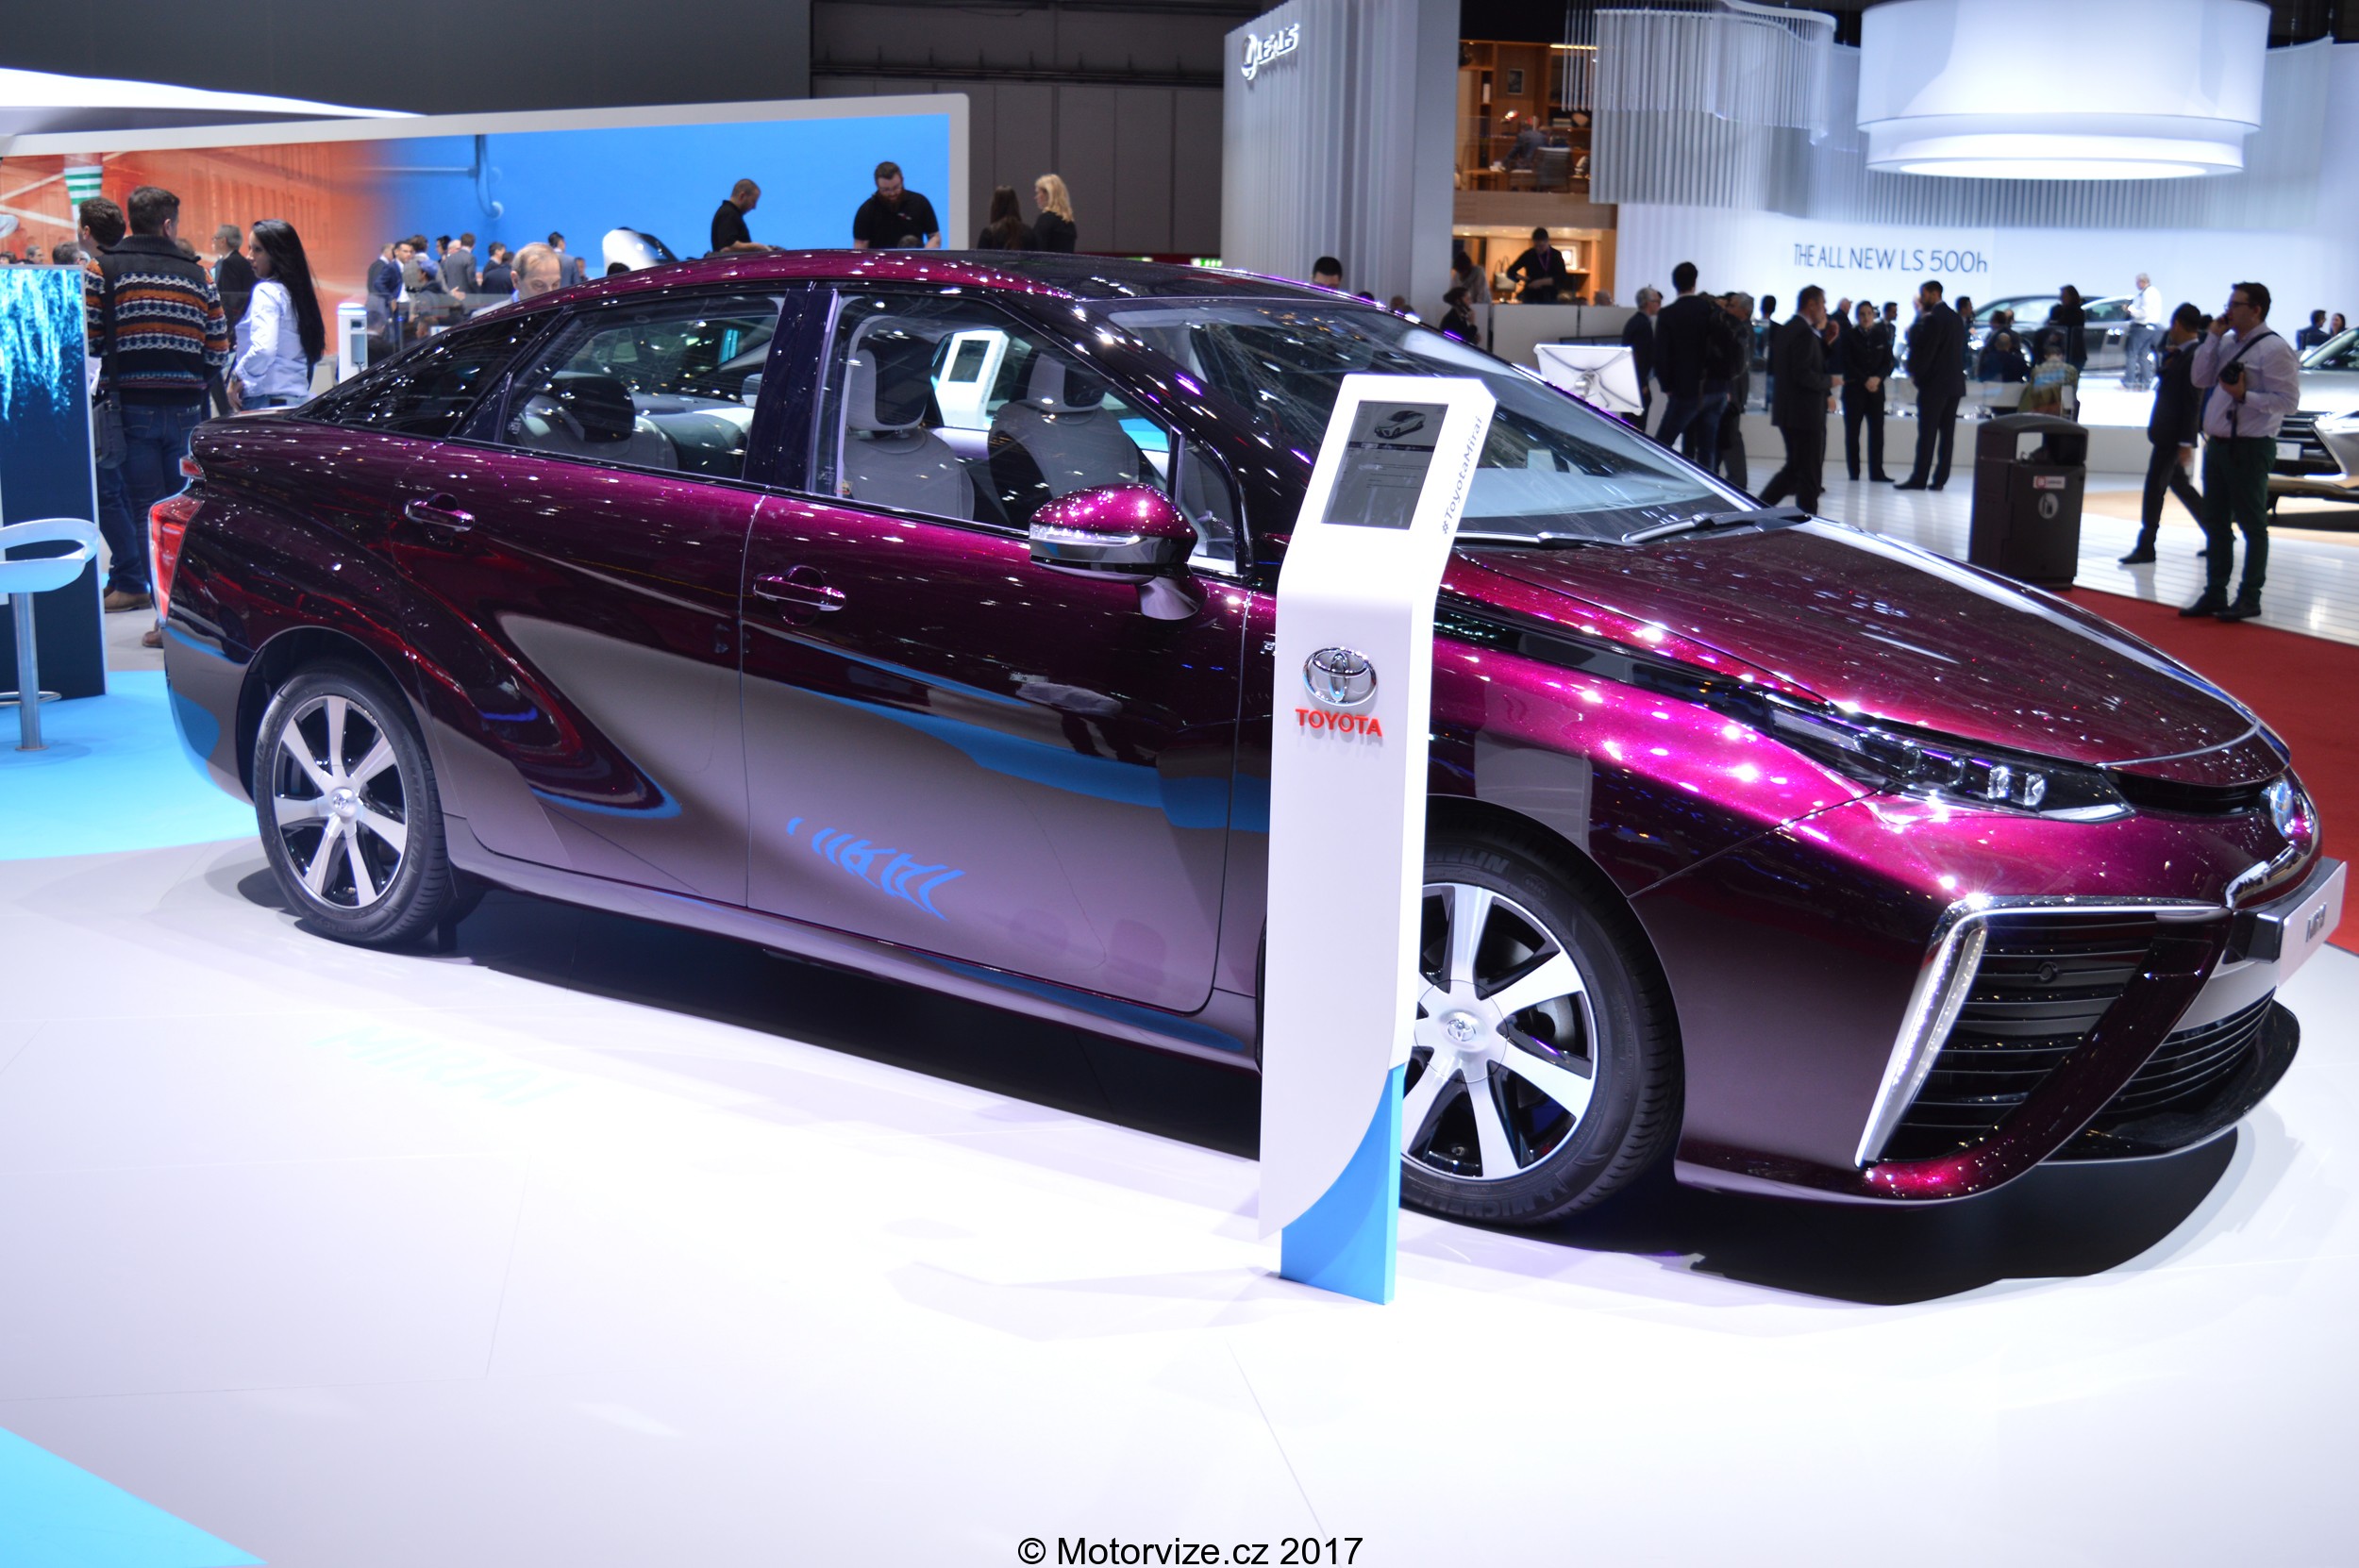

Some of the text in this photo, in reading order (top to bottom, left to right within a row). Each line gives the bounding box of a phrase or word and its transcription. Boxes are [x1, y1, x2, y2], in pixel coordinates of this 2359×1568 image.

[1794, 243, 1988, 273] THE ALL NEW LS 500h
[1442, 416, 1482, 534] #ToyotaMirai
[1295, 709, 1382, 737] TOYOTA
